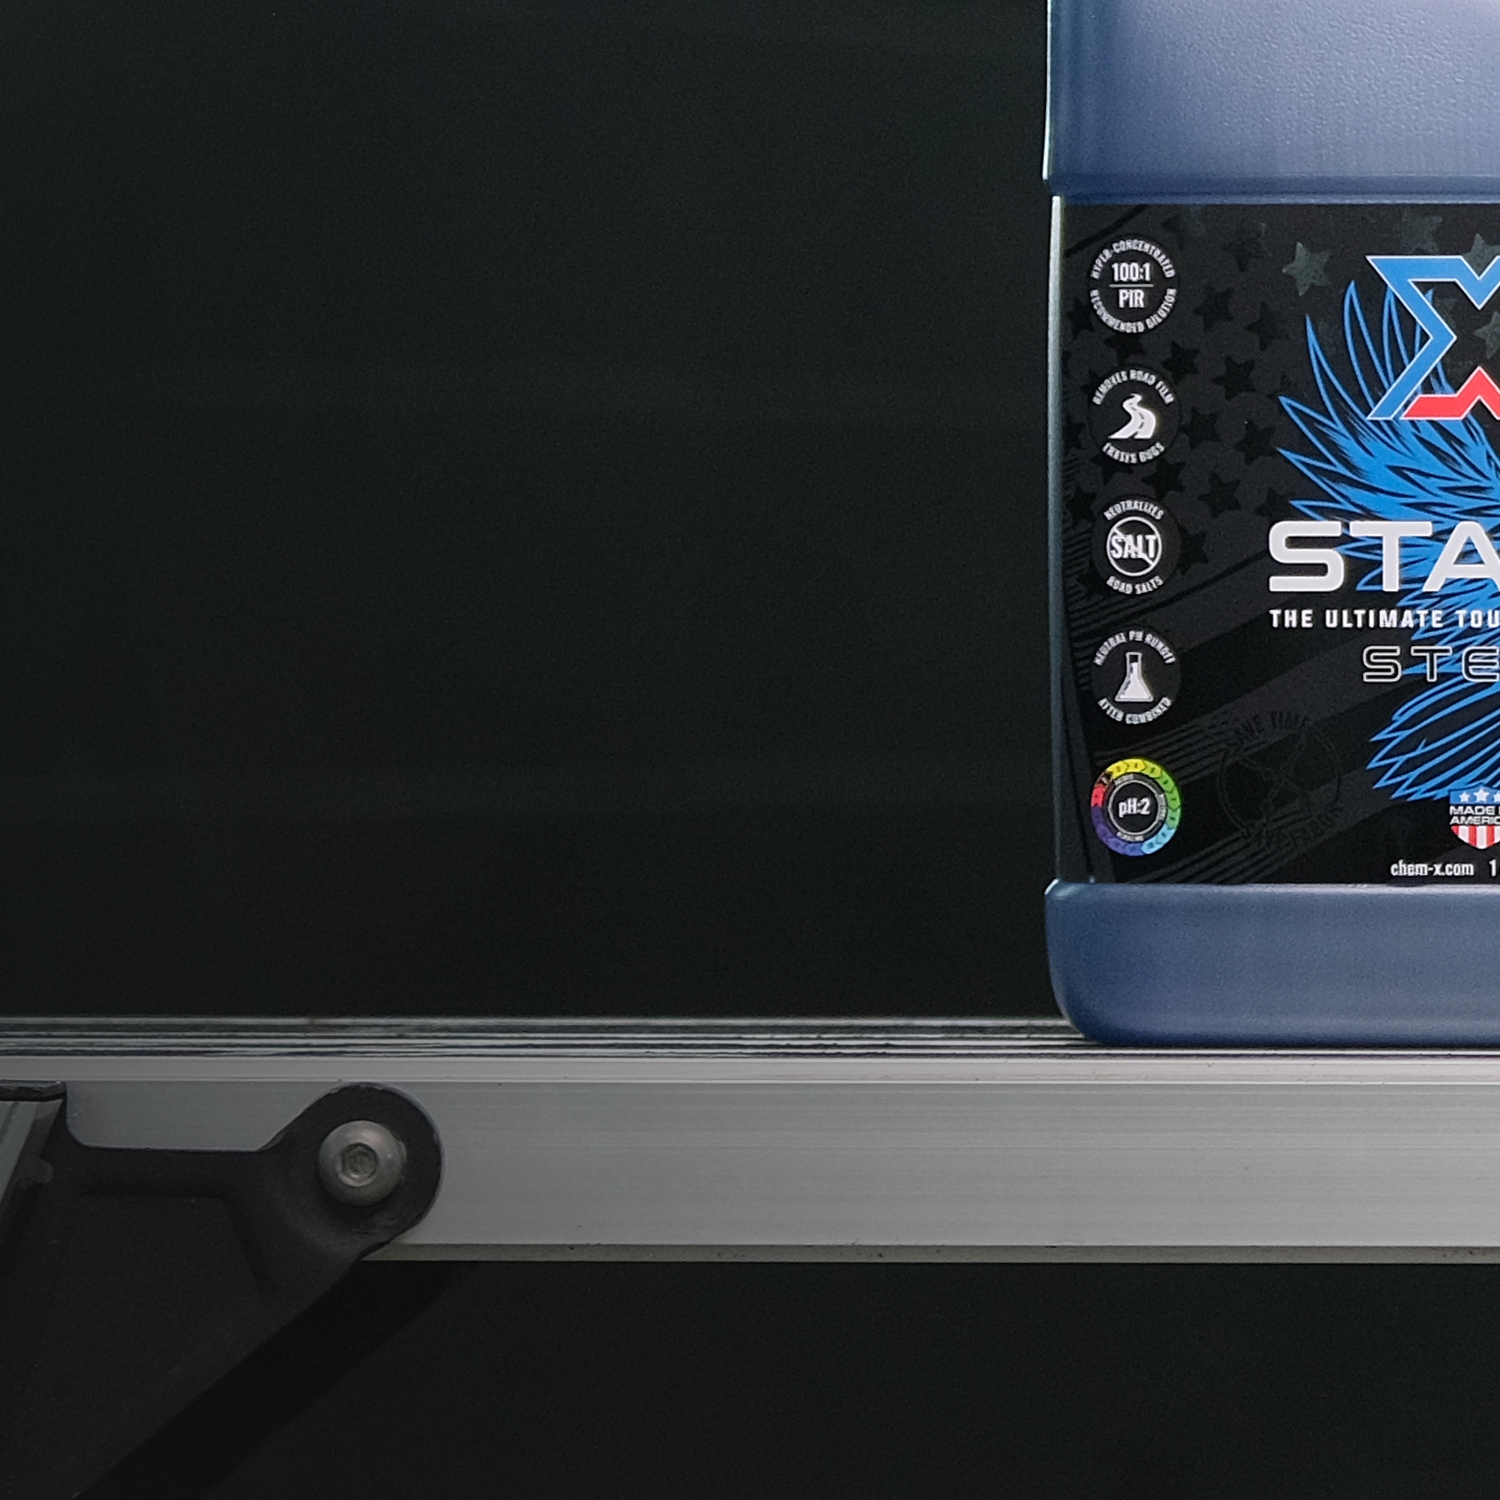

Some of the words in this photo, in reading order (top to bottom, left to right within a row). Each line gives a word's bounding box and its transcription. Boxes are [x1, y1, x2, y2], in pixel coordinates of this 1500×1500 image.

[1112, 262, 1150, 282] 100:1
[1119, 289, 1145, 309] PIR
[1110, 534, 1157, 559] SALT
[1106, 576, 1132, 594] ROAD
[1135, 575, 1164, 594] SALTS
[1269, 609, 1313, 628] THE
[1325, 609, 1443, 628] ULTIMATE
[1118, 798, 1150, 818] pH:2
[1449, 806, 1495, 815] MADE
[1390, 859, 1474, 877] chem-x.com
[1489, 859, 1497, 877] 1
